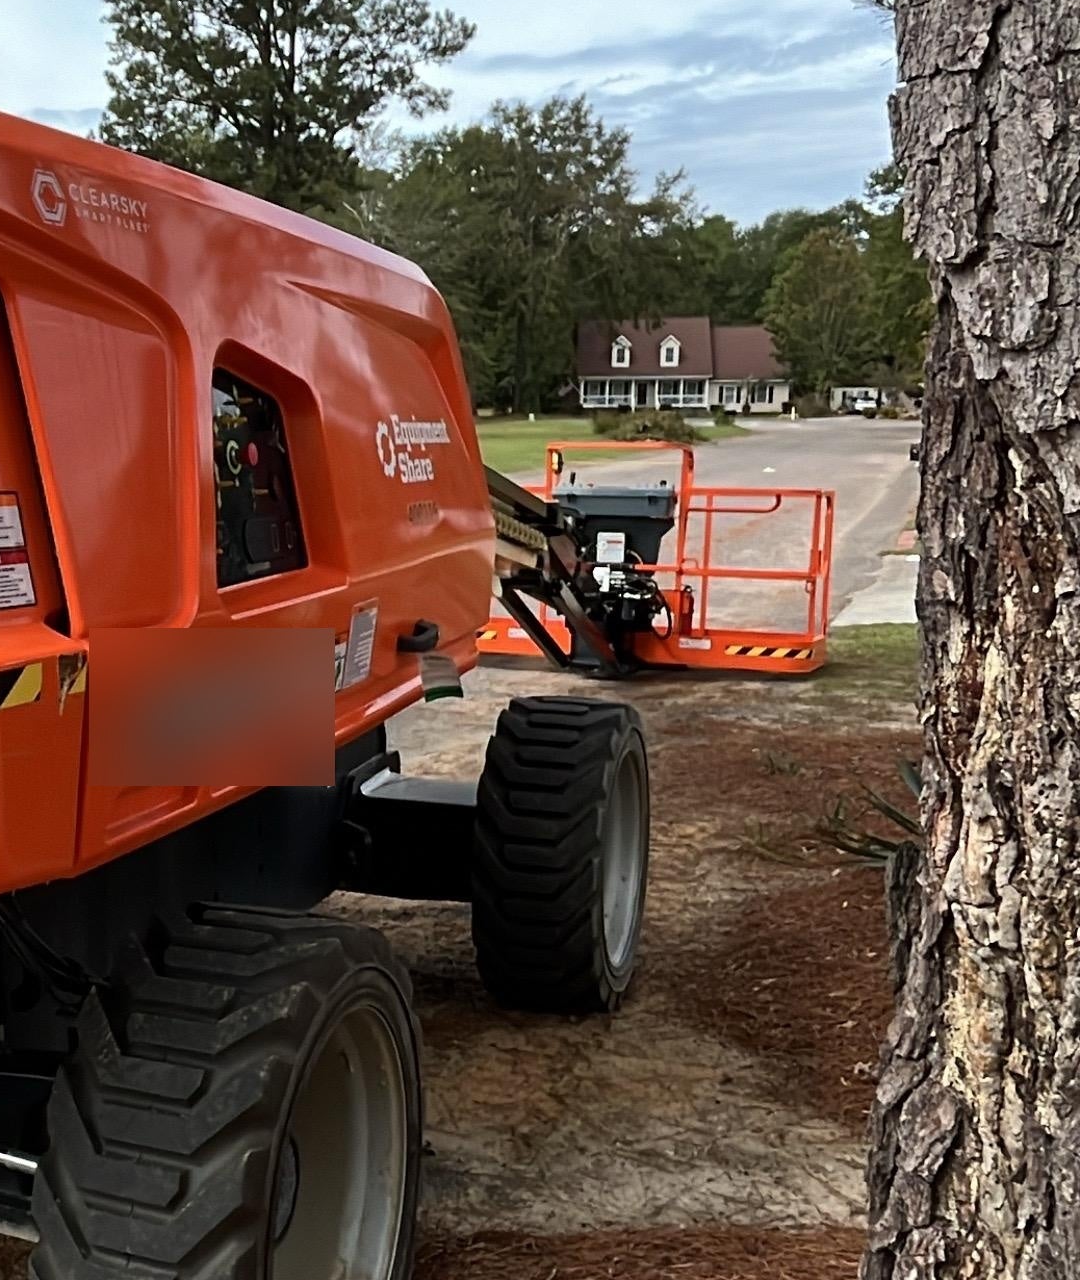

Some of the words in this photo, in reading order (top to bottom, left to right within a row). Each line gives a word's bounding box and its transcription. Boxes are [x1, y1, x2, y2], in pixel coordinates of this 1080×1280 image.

[68, 183, 148, 218] CLEARSKY
[390, 414, 451, 452] Equipment
[398, 452, 435, 484] Share
